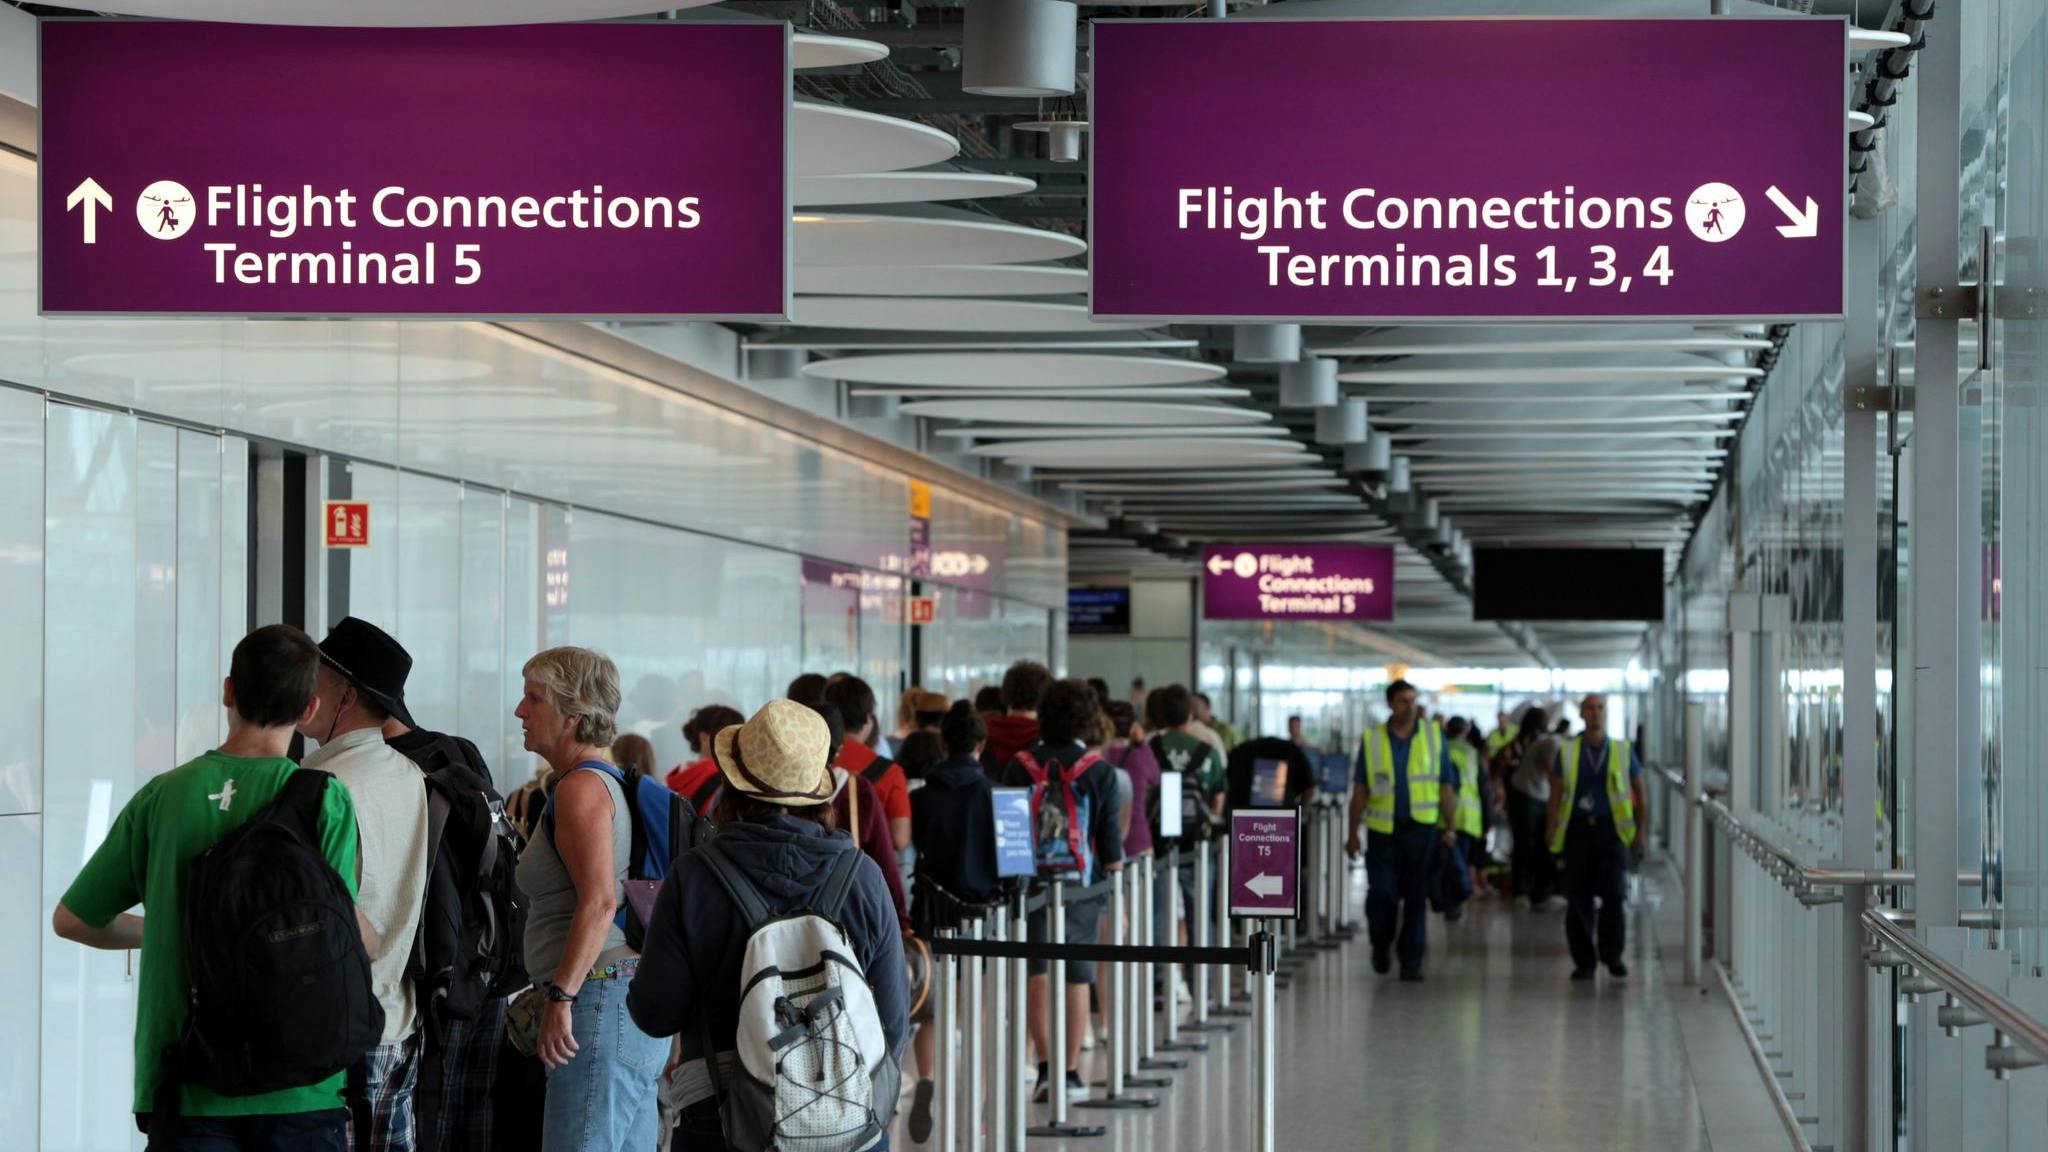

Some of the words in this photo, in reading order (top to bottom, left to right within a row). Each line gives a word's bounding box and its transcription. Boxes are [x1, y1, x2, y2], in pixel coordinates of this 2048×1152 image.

[209, 184, 356, 238] Flight
[373, 184, 701, 229] Connections
[1179, 184, 1327, 240] Flight
[1343, 185, 1673, 230] Connections
[204, 242, 435, 285] Terminal
[454, 243, 483, 285] 5
[1258, 244, 1517, 287] Terminals
[1259, 554, 1314, 576] Flight
[1258, 575, 1374, 594] Connections
[1258, 594, 1340, 613] Terminal
[1342, 594, 1356, 614] 5
[1239, 833, 1290, 842] Connections
[1253, 823, 1276, 832] Flight
[1257, 846, 1271, 856] T5
